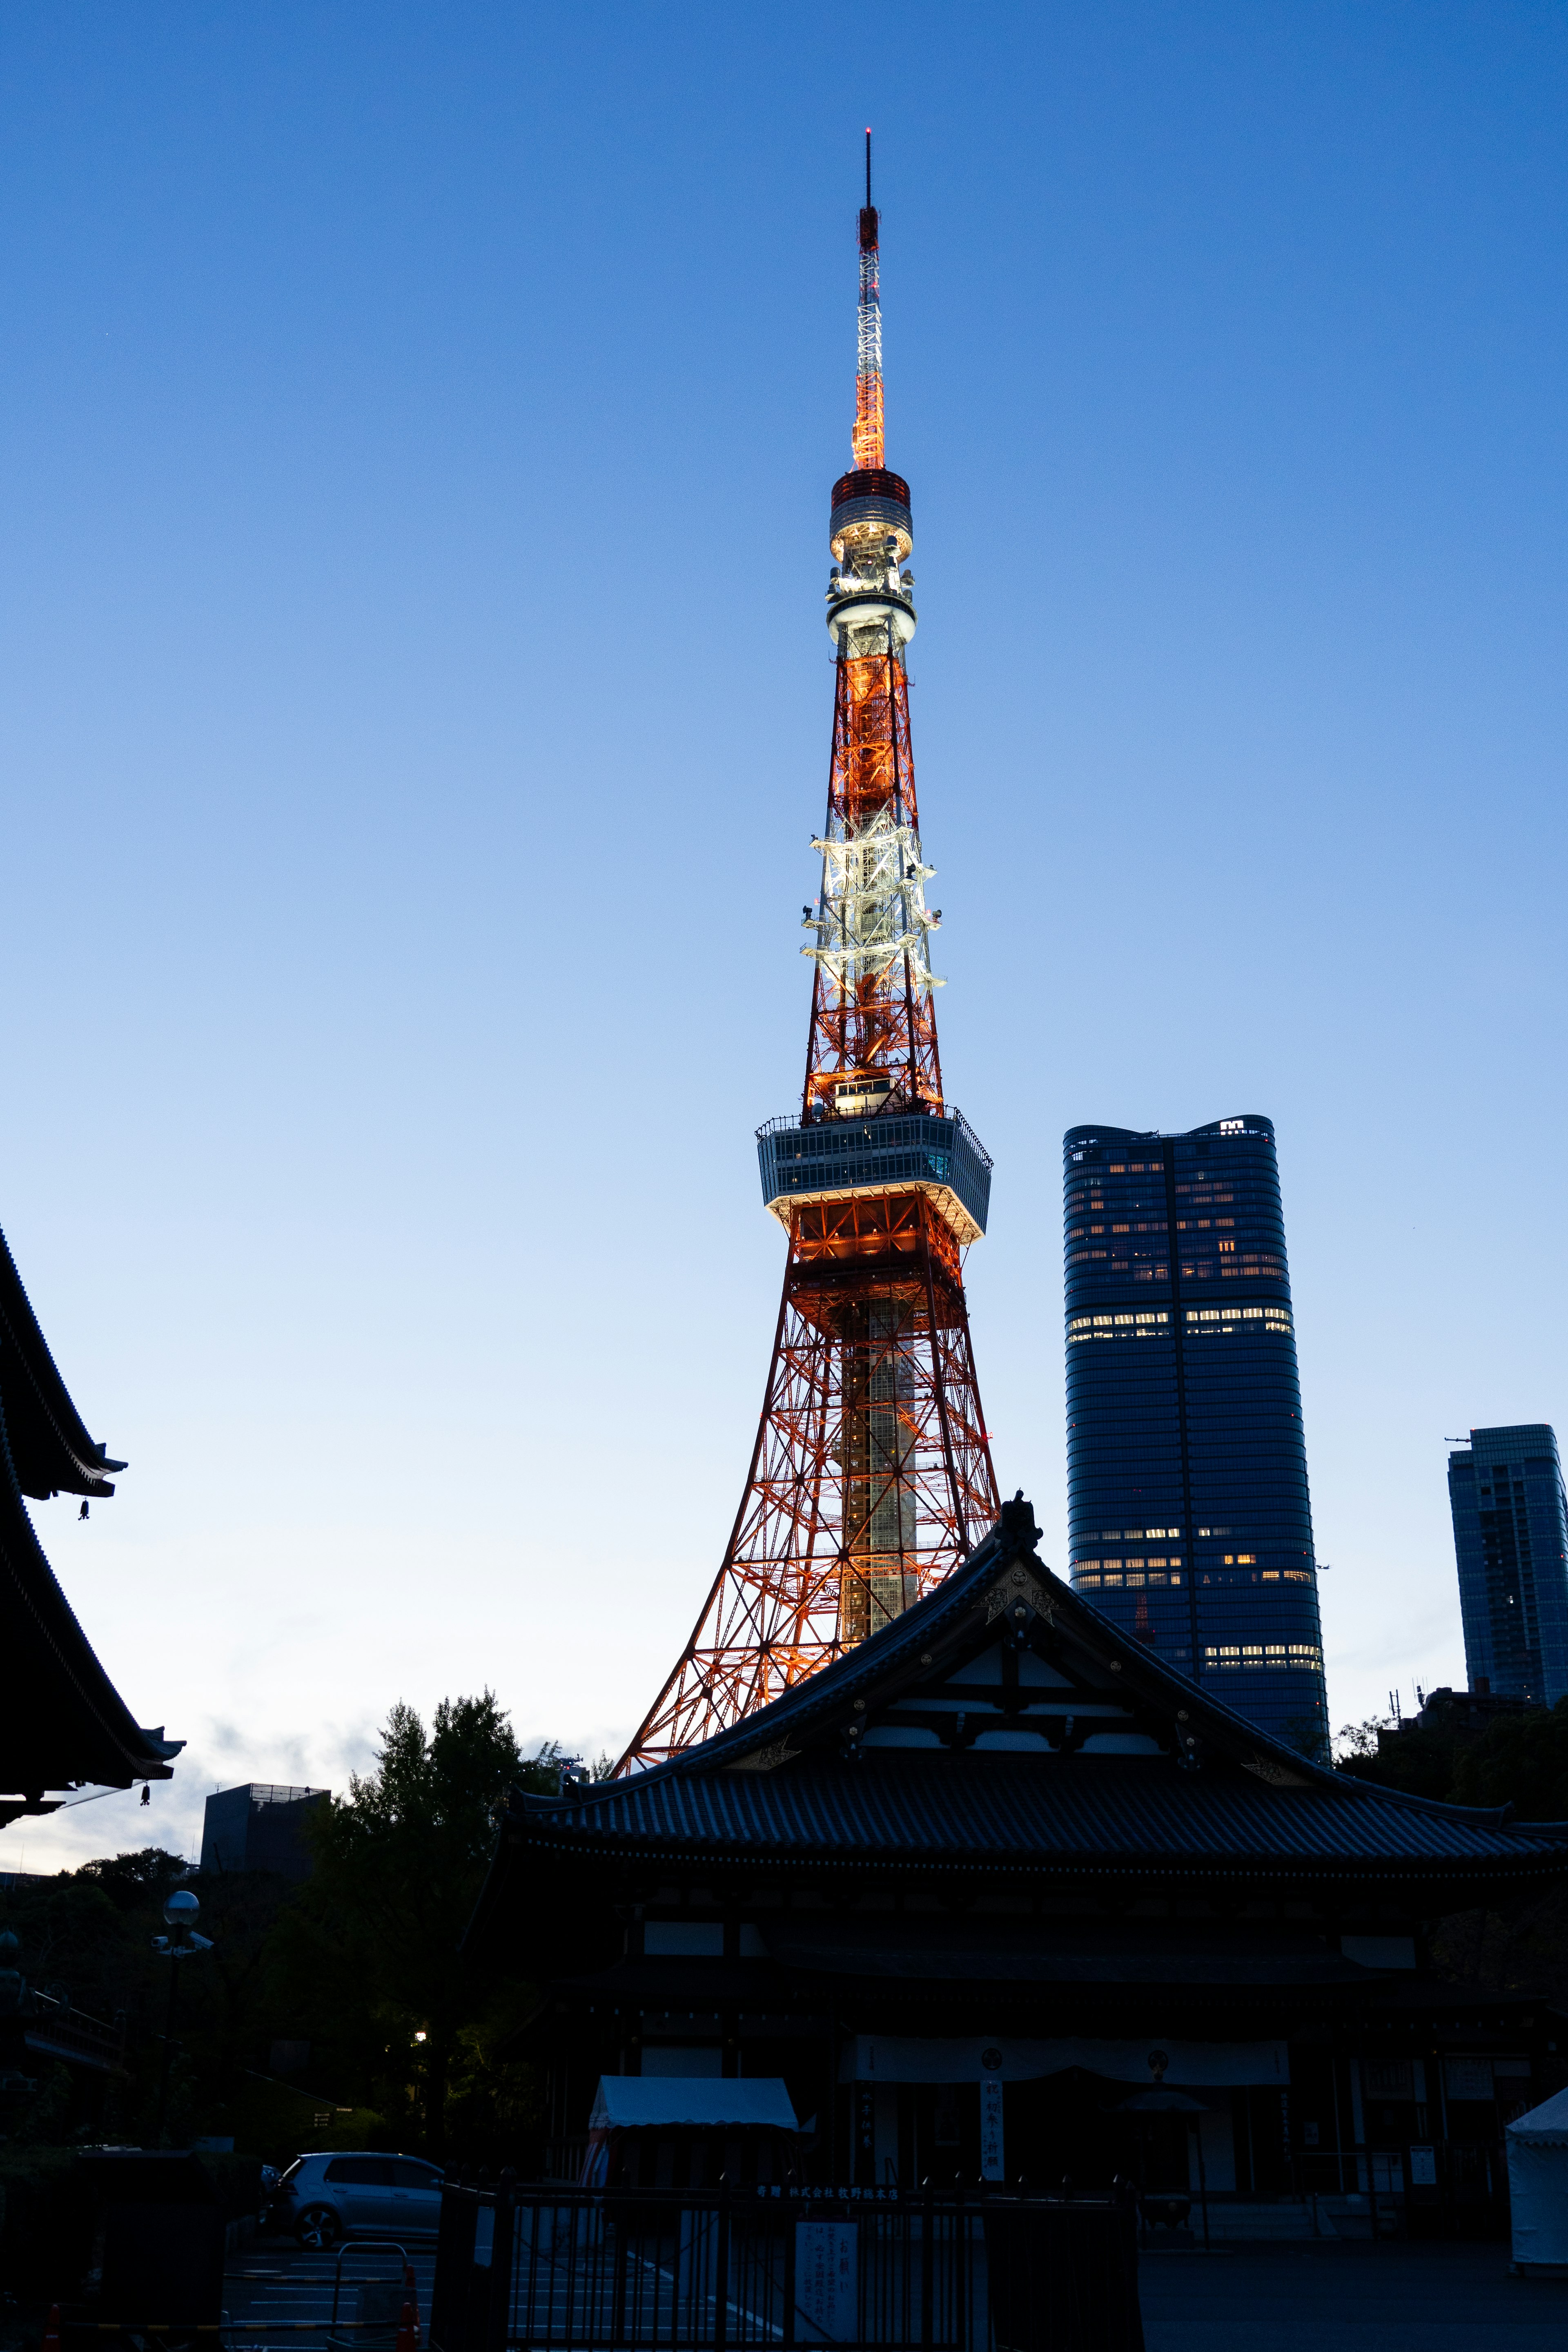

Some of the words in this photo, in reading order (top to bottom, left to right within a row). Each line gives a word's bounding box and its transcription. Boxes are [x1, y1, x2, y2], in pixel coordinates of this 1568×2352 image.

[861, 2091, 873, 2149] 水子供養
[839, 2238, 849, 2293] お願い
